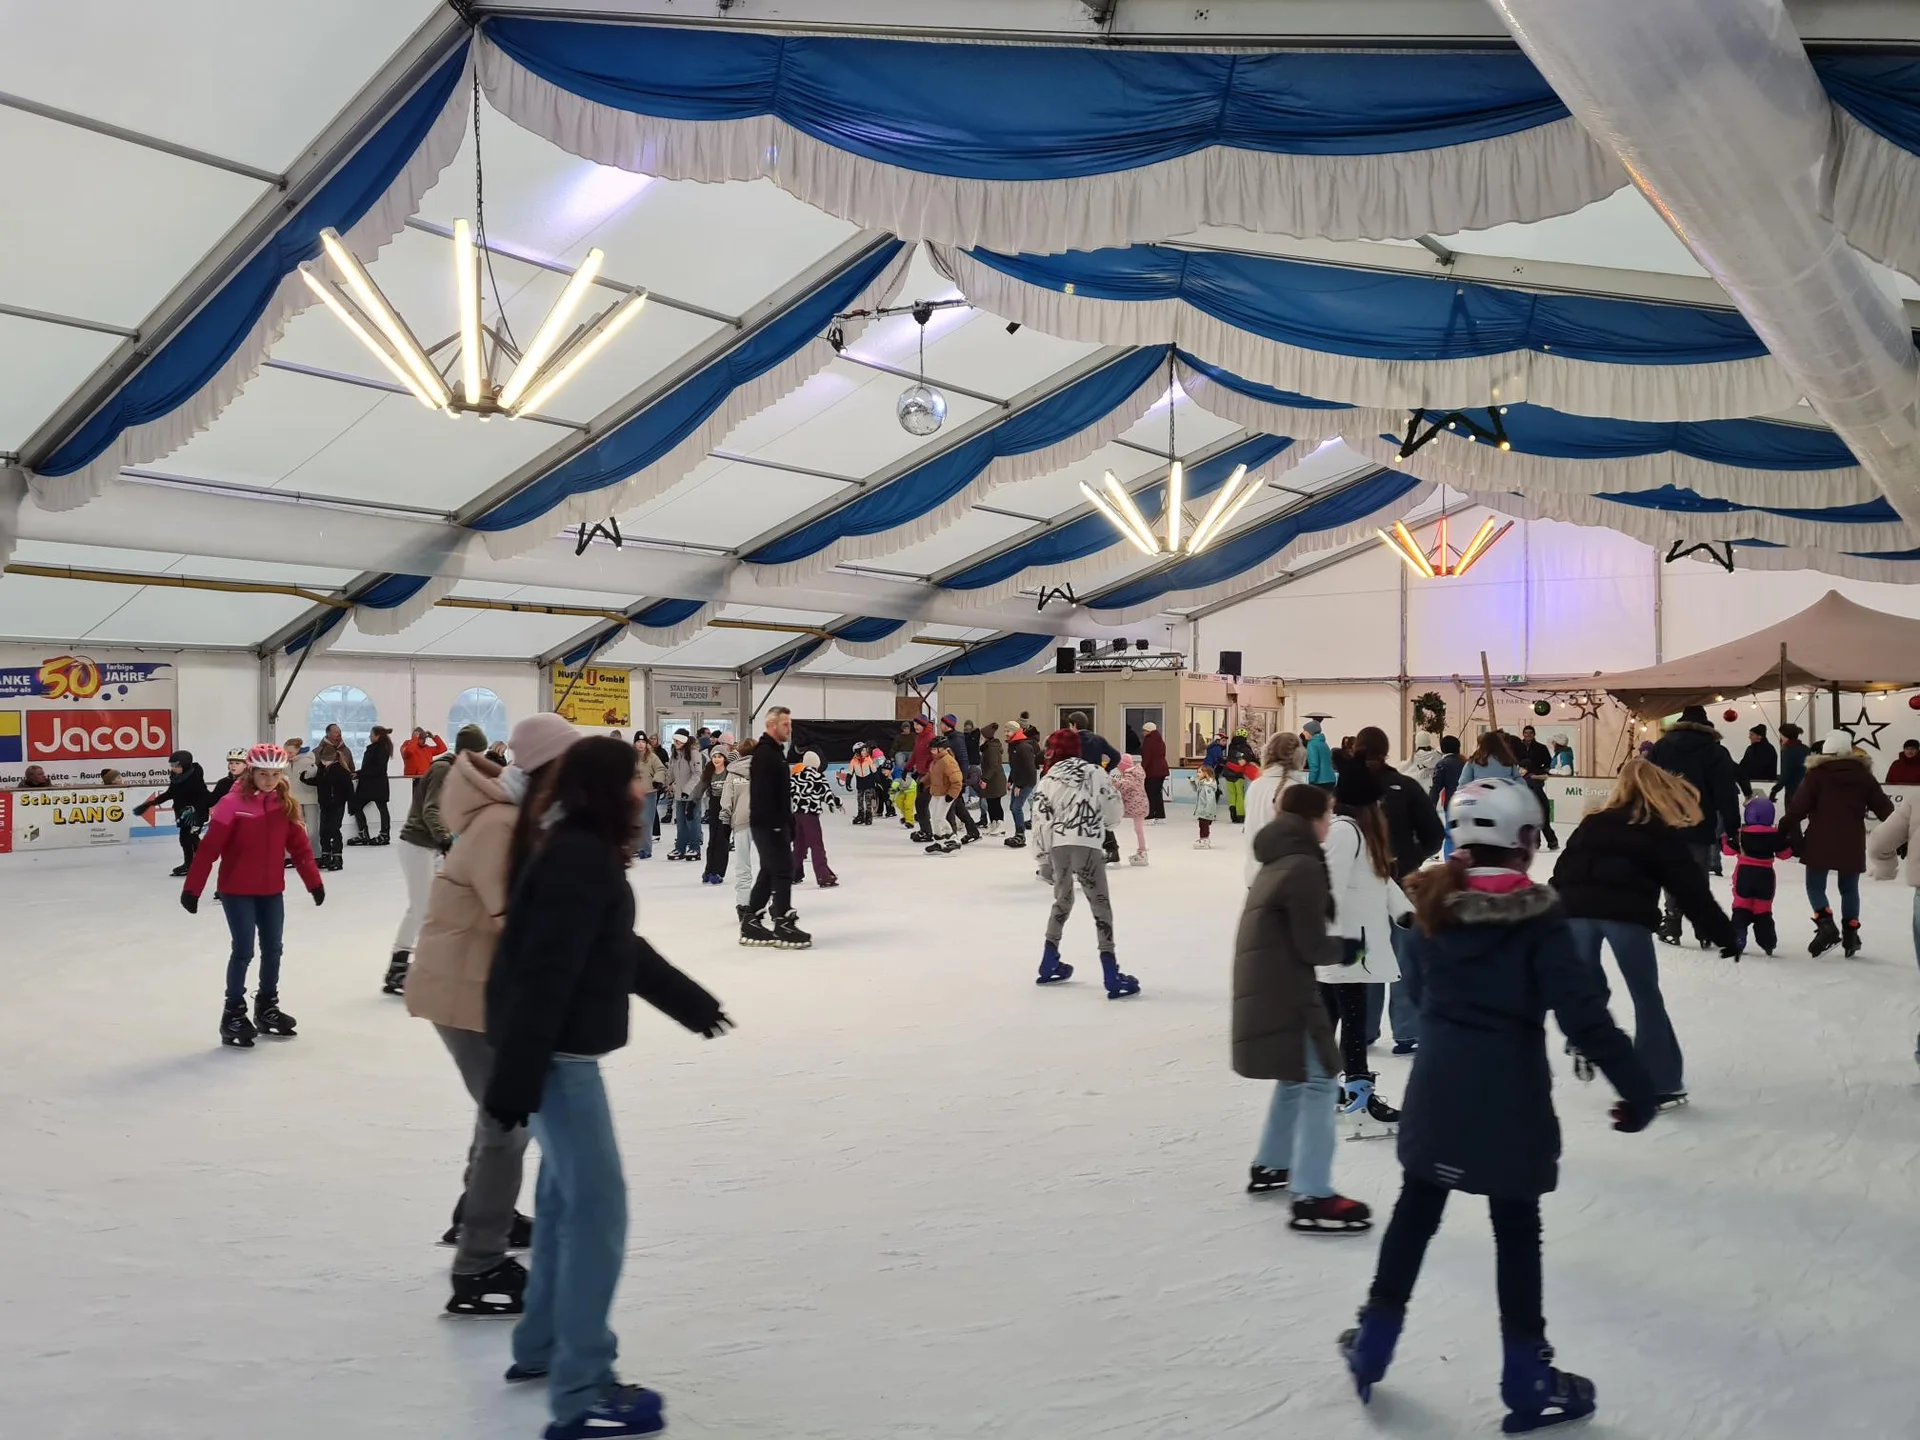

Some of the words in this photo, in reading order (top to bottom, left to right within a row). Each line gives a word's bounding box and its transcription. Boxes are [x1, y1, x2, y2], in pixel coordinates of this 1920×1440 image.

[106, 663, 134, 671] farbige
[0, 675, 31, 686] NKE
[40, 656, 101, 698] 50
[105, 672, 145, 682] JAHRE
[599, 674, 625, 683] GmbH
[33, 716, 166, 753] Jacob
[1565, 787, 1583, 796] Mit
[20, 790, 124, 807] Schreinerei
[53, 806, 124, 824] LANG
